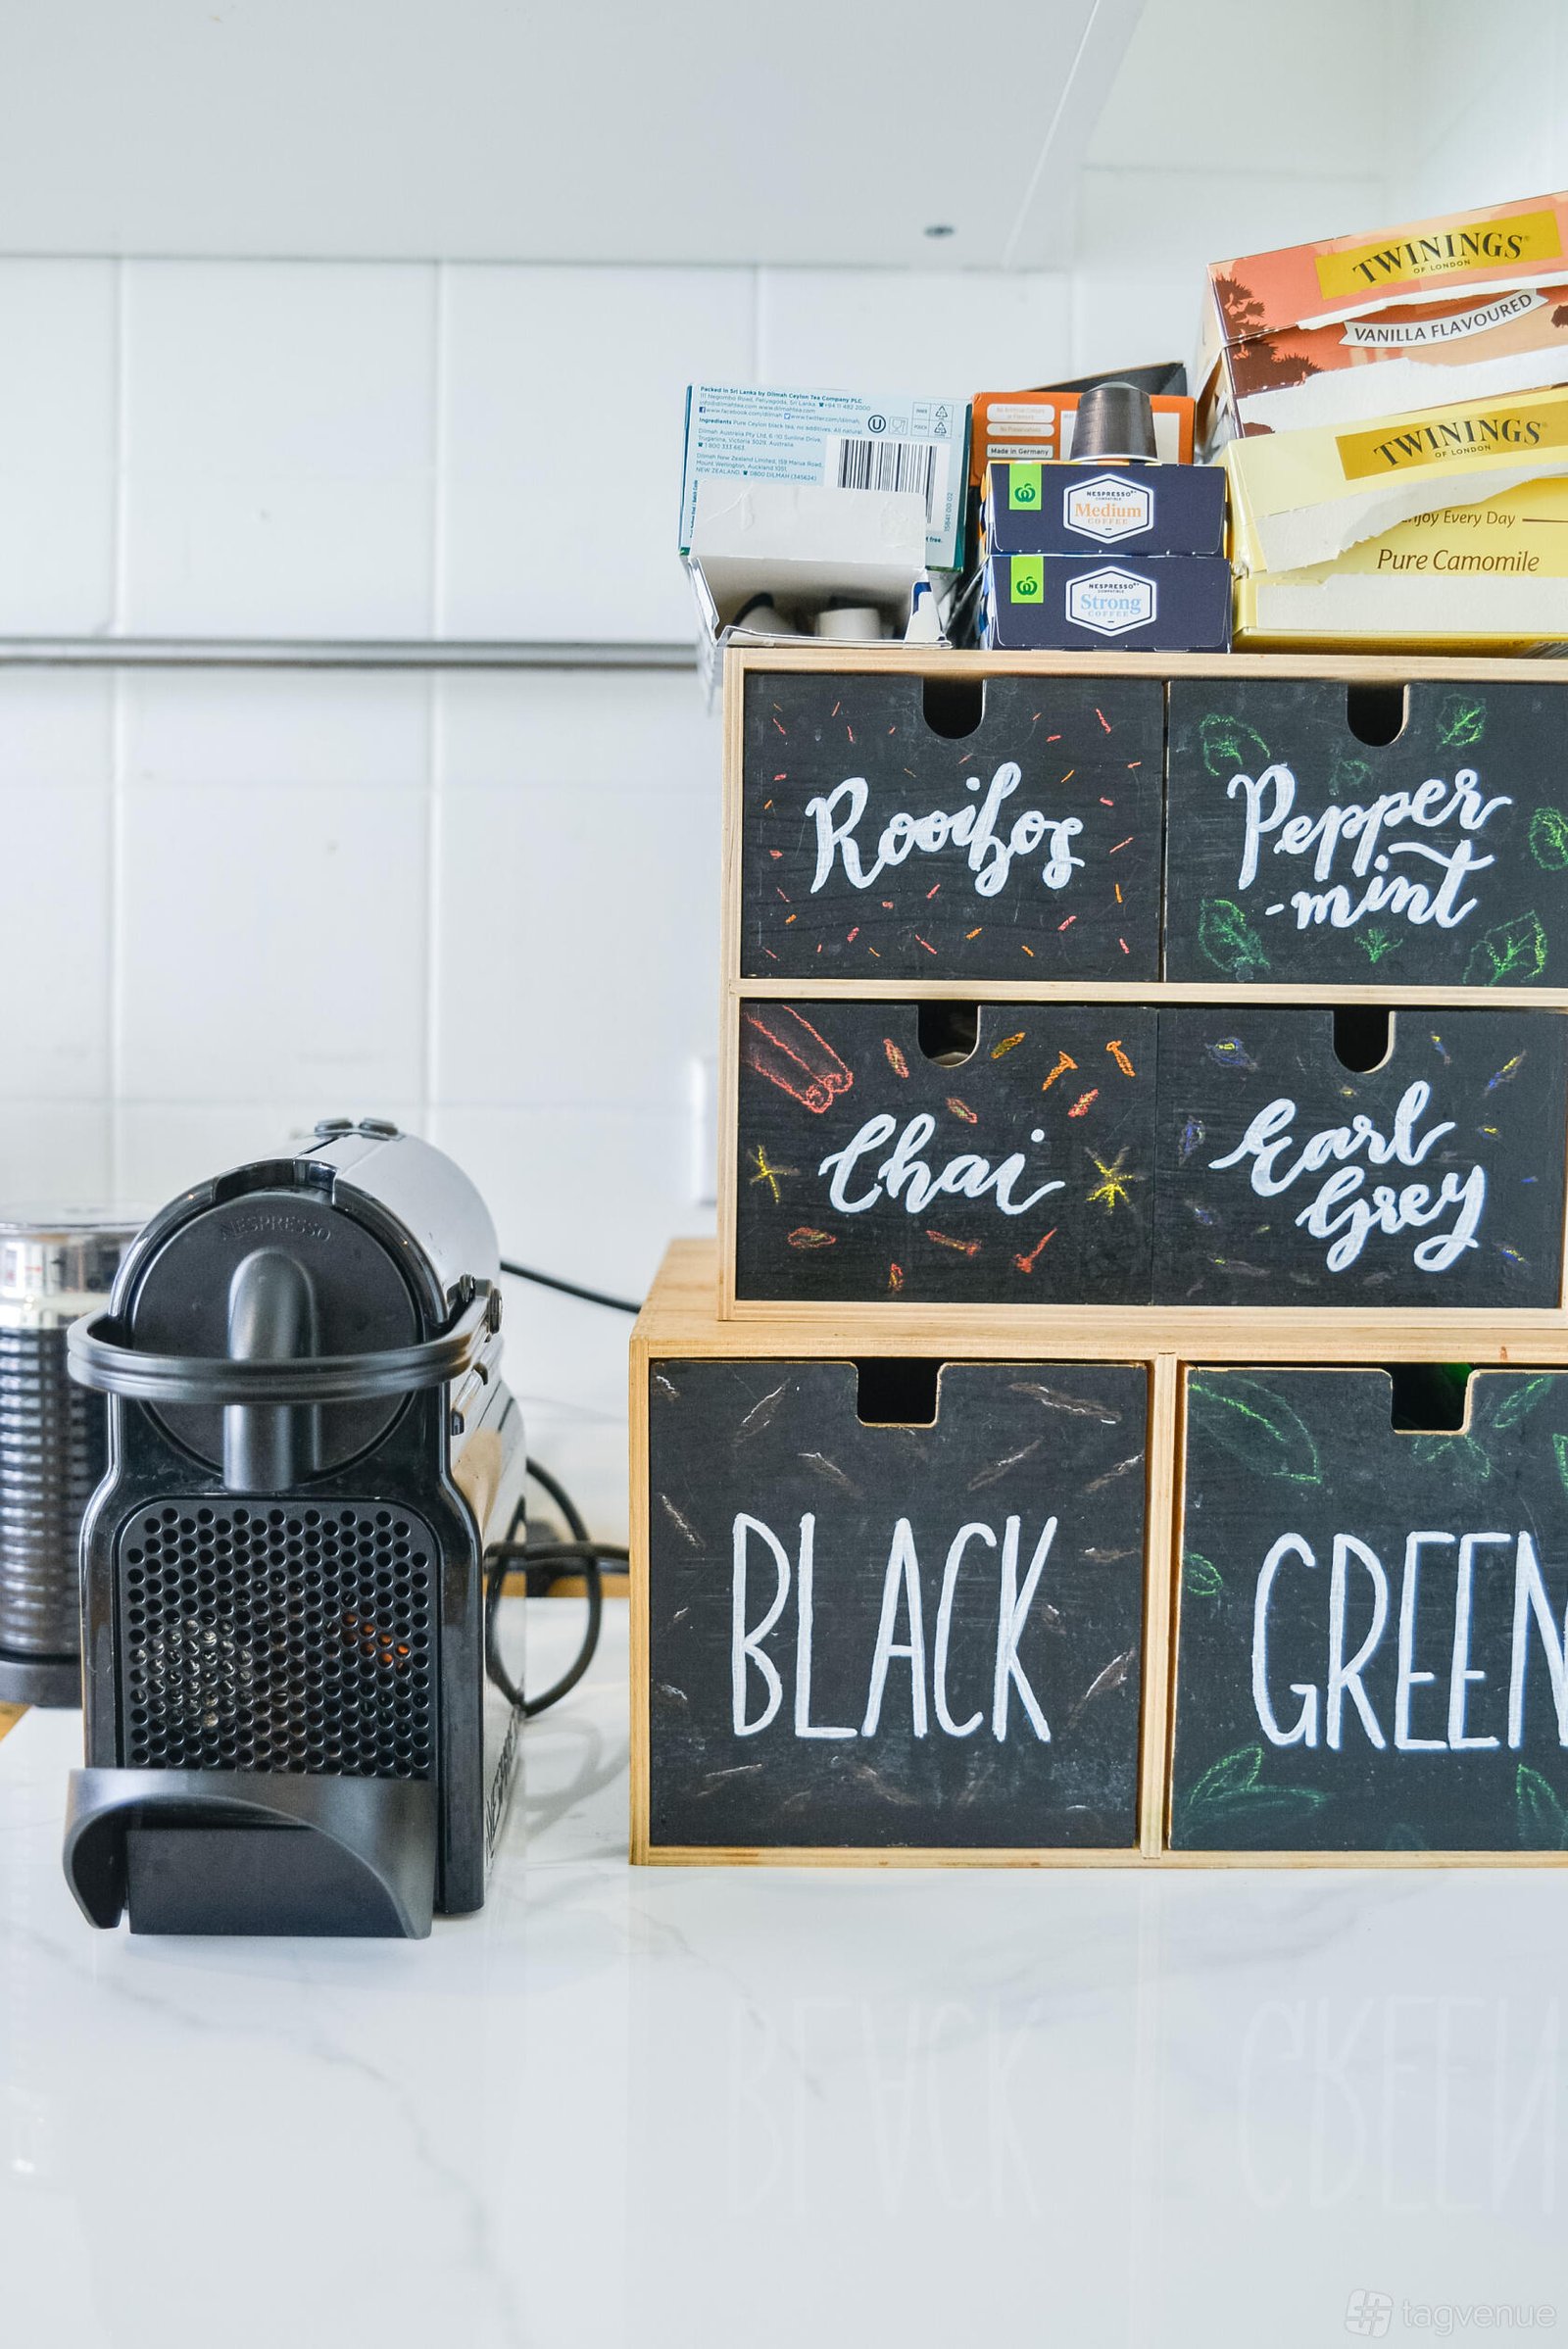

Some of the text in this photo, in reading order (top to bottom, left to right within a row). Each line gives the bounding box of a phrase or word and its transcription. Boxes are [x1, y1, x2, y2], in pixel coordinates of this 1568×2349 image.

[1413, 259, 1471, 274] OF LONDON
[1354, 293, 1533, 343] VANILLA FLAVOURED
[1435, 444, 1492, 459] OF LONDON
[1075, 502, 1142, 517] Medium
[1444, 510, 1482, 528] Every
[1487, 511, 1516, 528] Day
[1376, 549, 1540, 572] Pure Camomile
[1081, 594, 1142, 614] Strong
[806, 761, 1085, 897] Rooibos
[1227, 764, 1512, 889] Pepper
[818, 1113, 1065, 1215] Chai
[1208, 1080, 1455, 1197] Earl
[1295, 1164, 1485, 1272] Grey
[732, 1512, 1057, 1741] BLACK
[1251, 1532, 1568, 1749] GREEN
